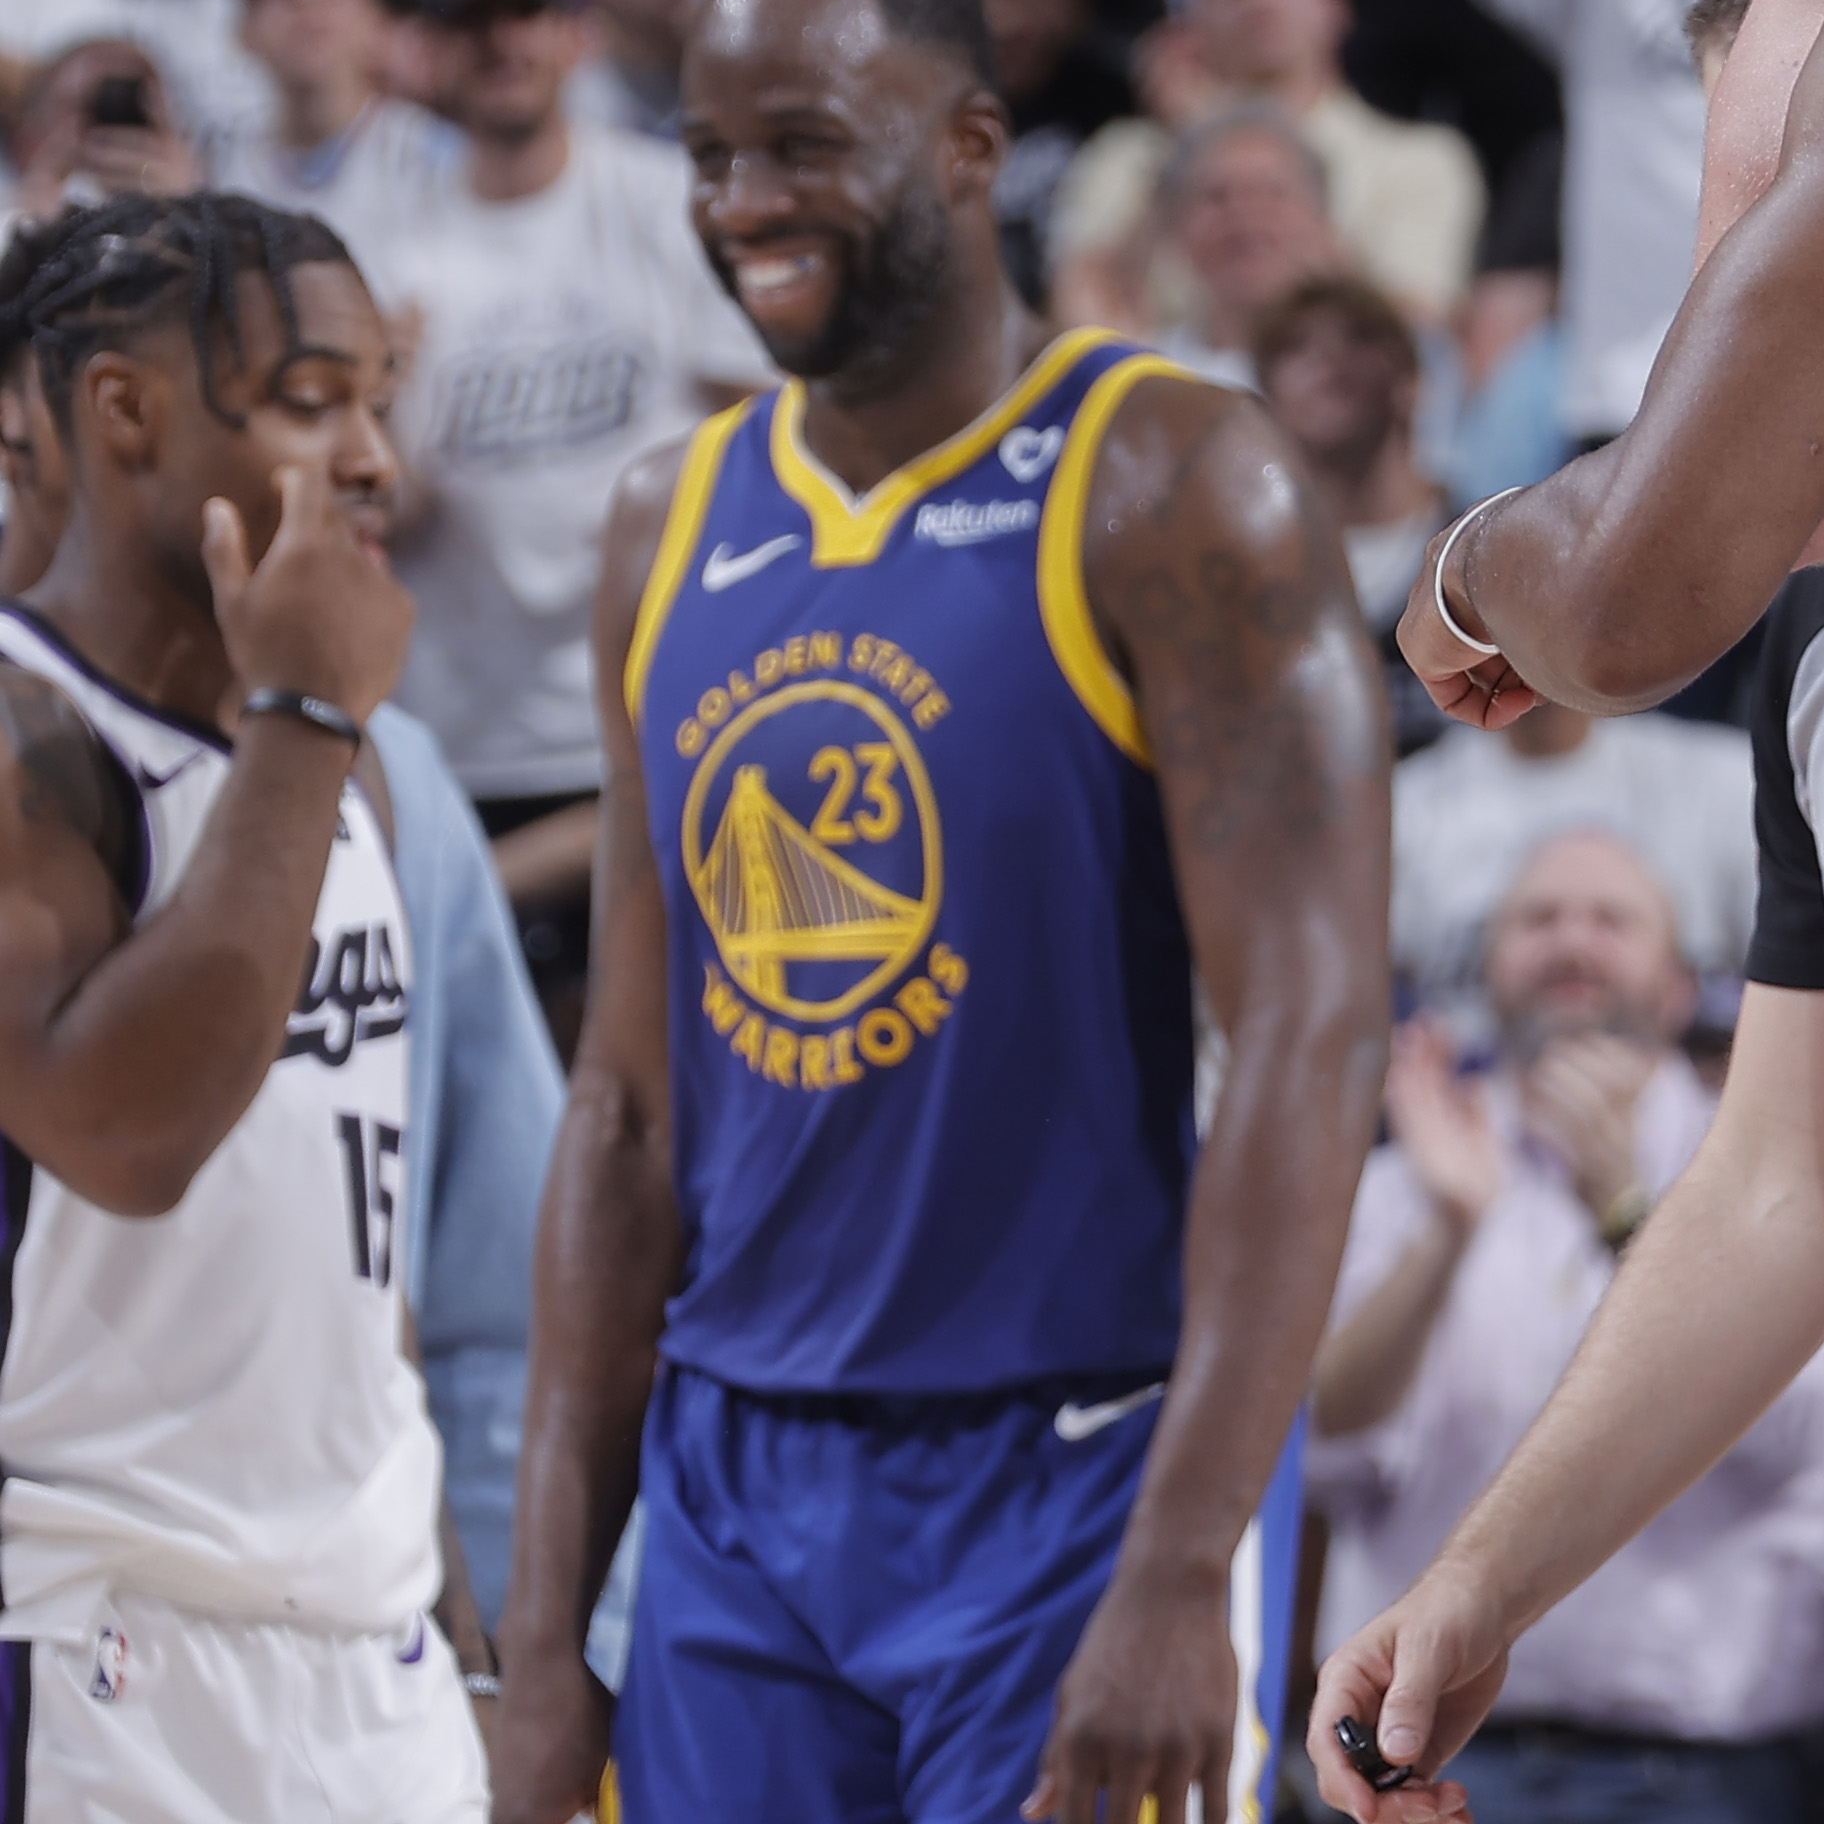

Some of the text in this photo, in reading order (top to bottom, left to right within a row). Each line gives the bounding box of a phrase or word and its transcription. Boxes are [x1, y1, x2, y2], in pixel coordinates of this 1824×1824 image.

[675, 630, 952, 758] GOLDEN STATE
[808, 742, 903, 844] 23
[702, 942, 970, 1092] WARRIORS
